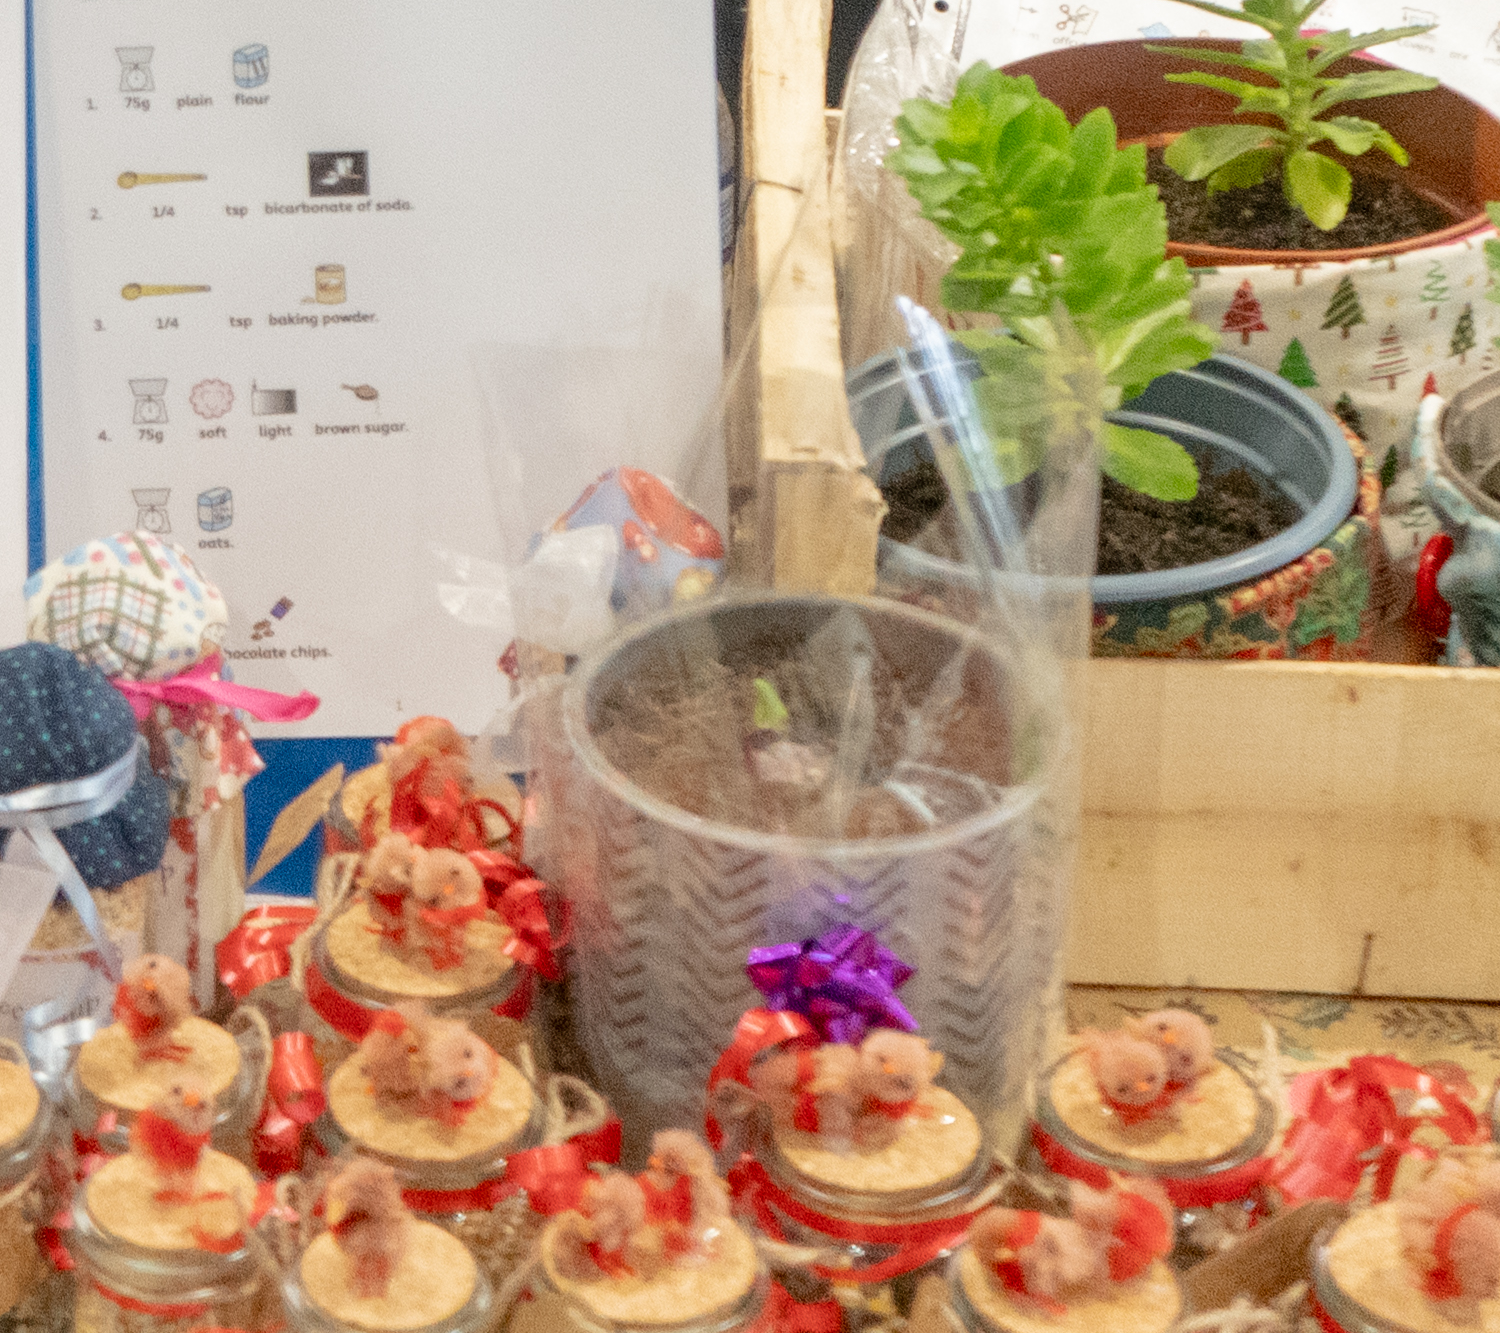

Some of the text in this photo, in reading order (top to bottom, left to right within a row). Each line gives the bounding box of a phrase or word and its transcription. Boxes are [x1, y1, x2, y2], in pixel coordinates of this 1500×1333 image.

[124, 96, 151, 113] 75g
[175, 93, 214, 111] plain
[234, 92, 271, 107] flour
[90, 199, 415, 222] 2. 1/4 tsp bicarbonate of soda.
[156, 316, 180, 331] 1/4
[229, 315, 252, 330] tsp
[268, 313, 319, 329] baking
[322, 311, 379, 328] powder.
[138, 428, 165, 444] 75g
[198, 426, 228, 440] soft
[259, 424, 293, 441] light
[315, 422, 361, 437] brown
[364, 421, 410, 437] sugar.
[198, 538, 235, 550] oats.
[223, 644, 333, 660] hocolate chips.
